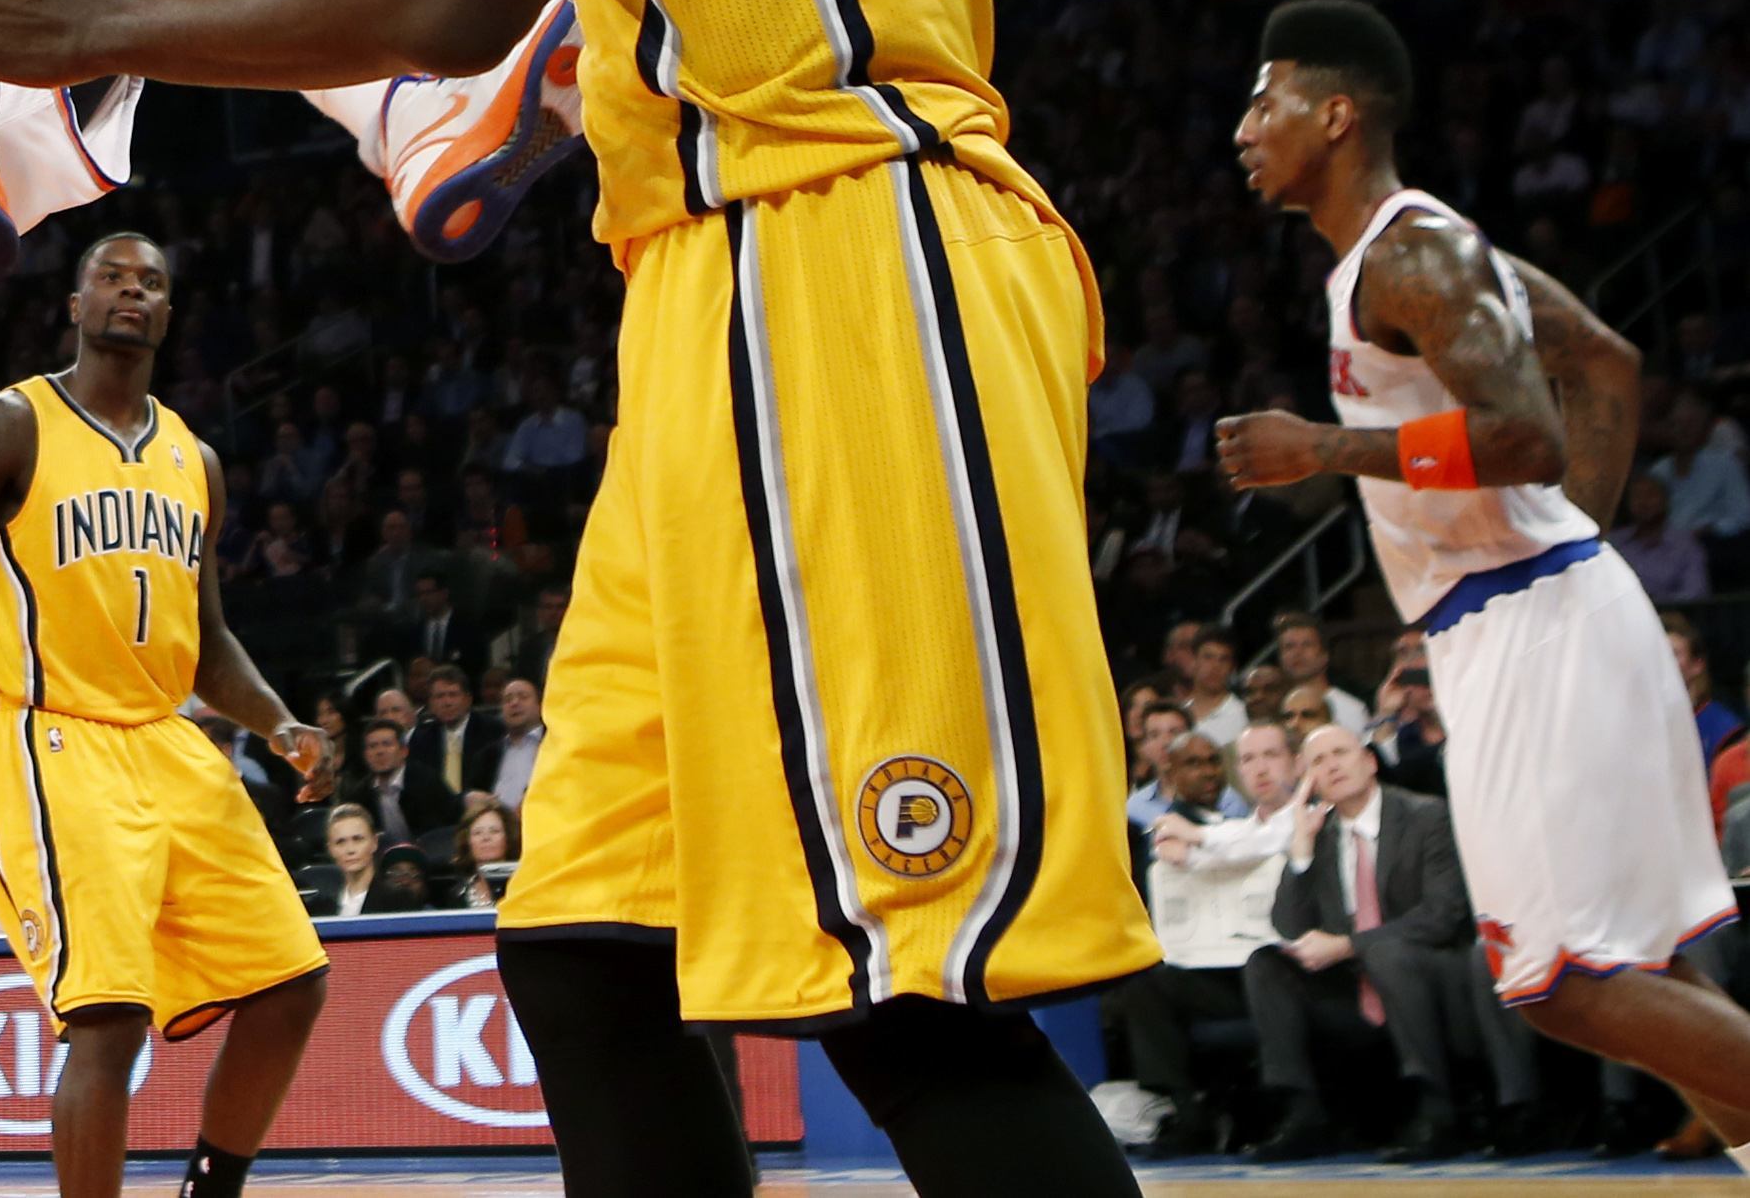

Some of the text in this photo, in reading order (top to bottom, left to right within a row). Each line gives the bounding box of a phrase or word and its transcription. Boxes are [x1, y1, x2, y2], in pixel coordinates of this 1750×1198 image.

[54, 488, 203, 570] INDIANA
[132, 567, 151, 647] 1
[428, 994, 539, 1088] KI
